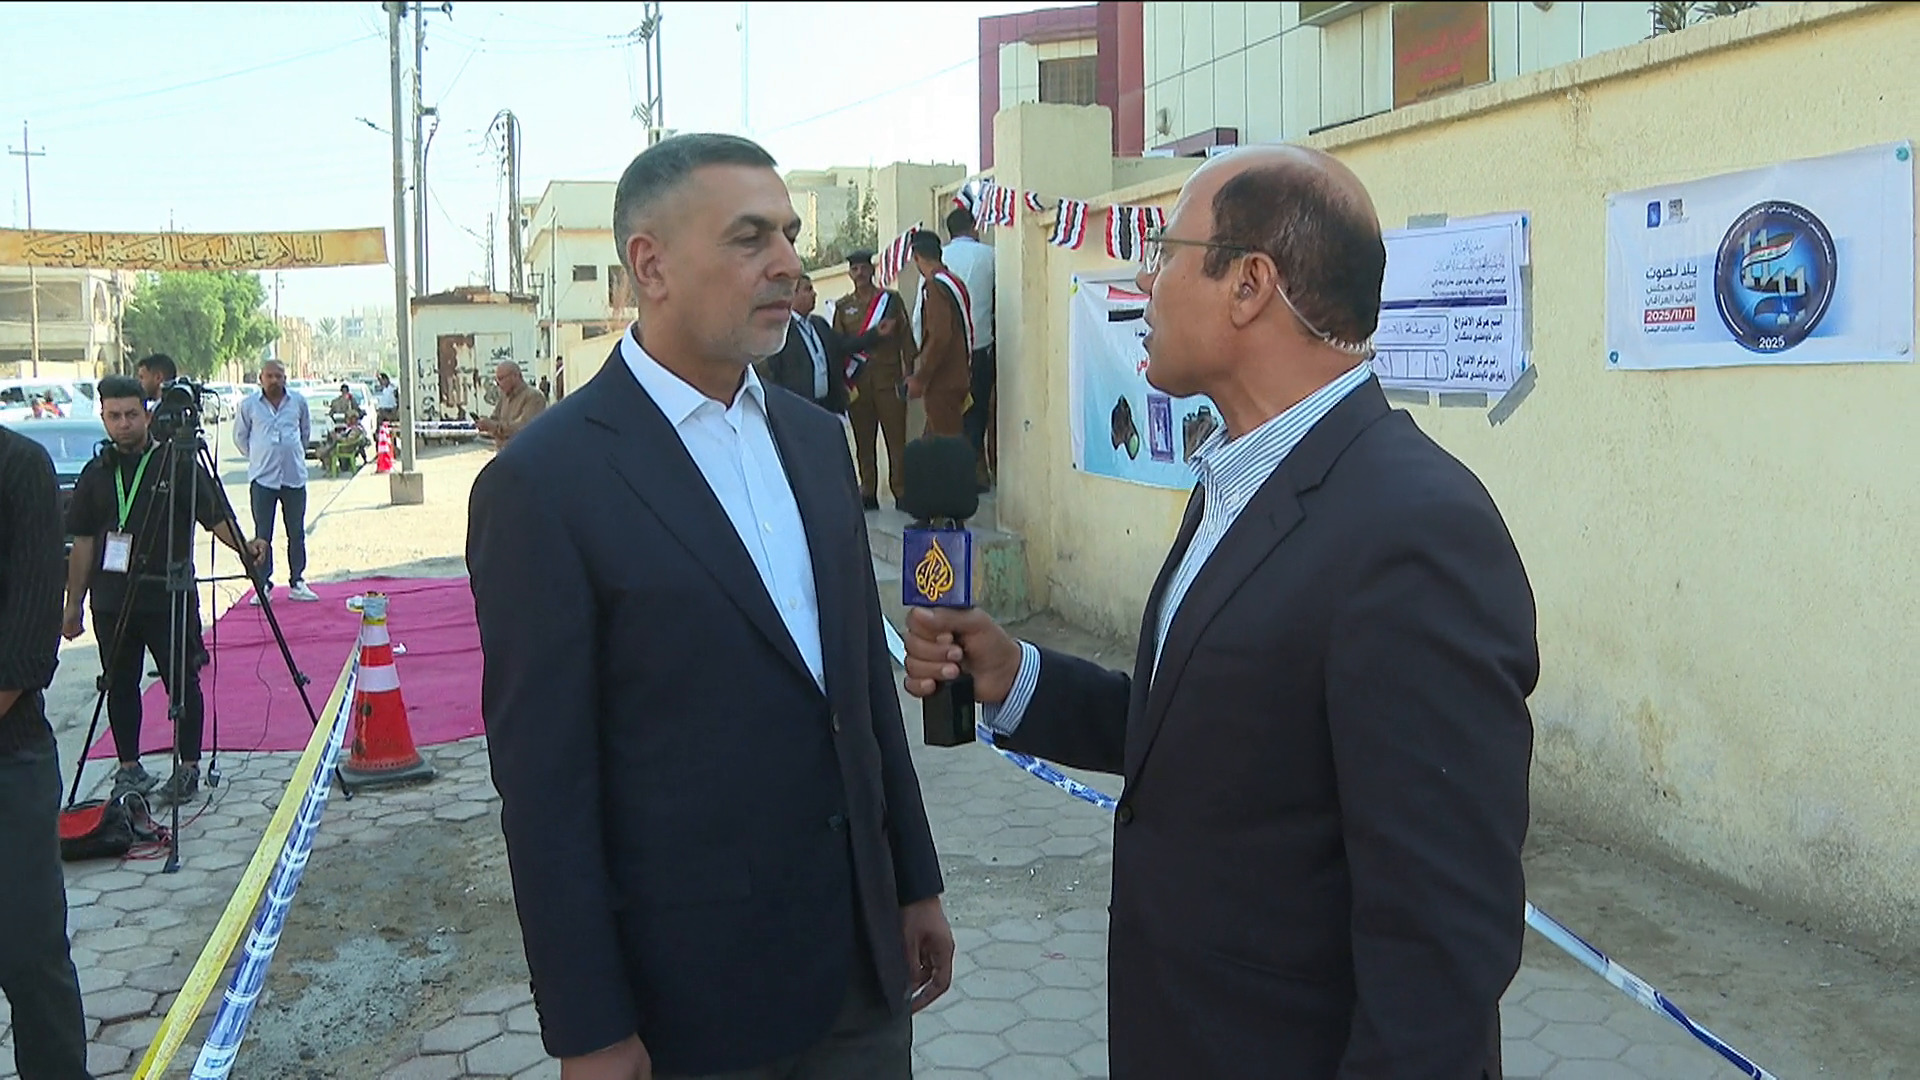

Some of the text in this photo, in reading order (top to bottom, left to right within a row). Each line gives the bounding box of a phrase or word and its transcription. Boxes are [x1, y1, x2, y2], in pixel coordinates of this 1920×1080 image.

[267, 234, 323, 267] السلام
[1646, 308, 1693, 322] 2025/11/11
[1758, 335, 1785, 349] 2025
